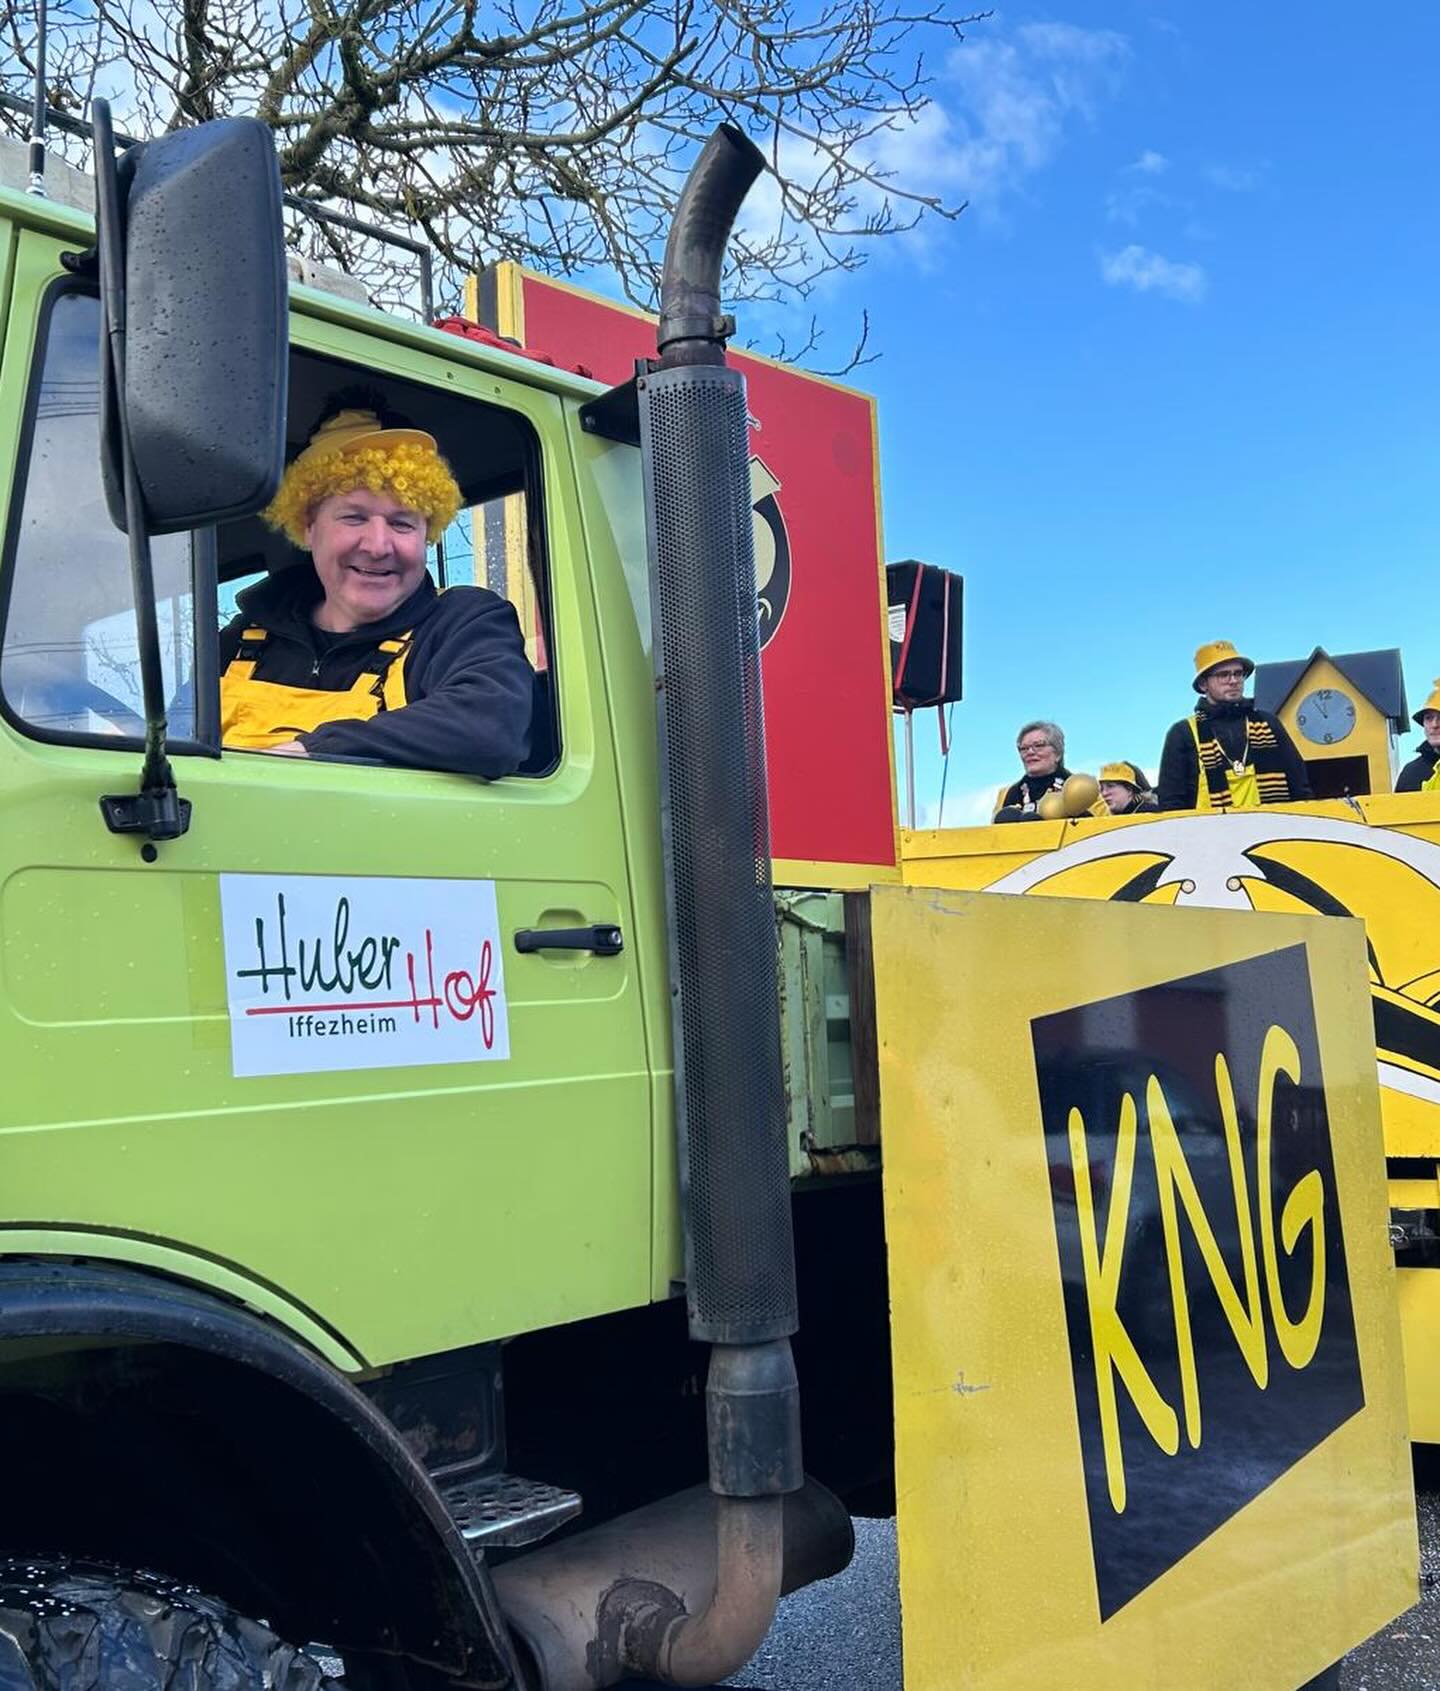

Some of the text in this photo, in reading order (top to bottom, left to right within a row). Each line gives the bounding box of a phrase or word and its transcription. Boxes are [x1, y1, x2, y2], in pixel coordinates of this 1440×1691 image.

[236, 892, 497, 1050] Huber Hof
[288, 1013, 397, 1038] Iffezheim
[1068, 1024, 1326, 1514] KNG
